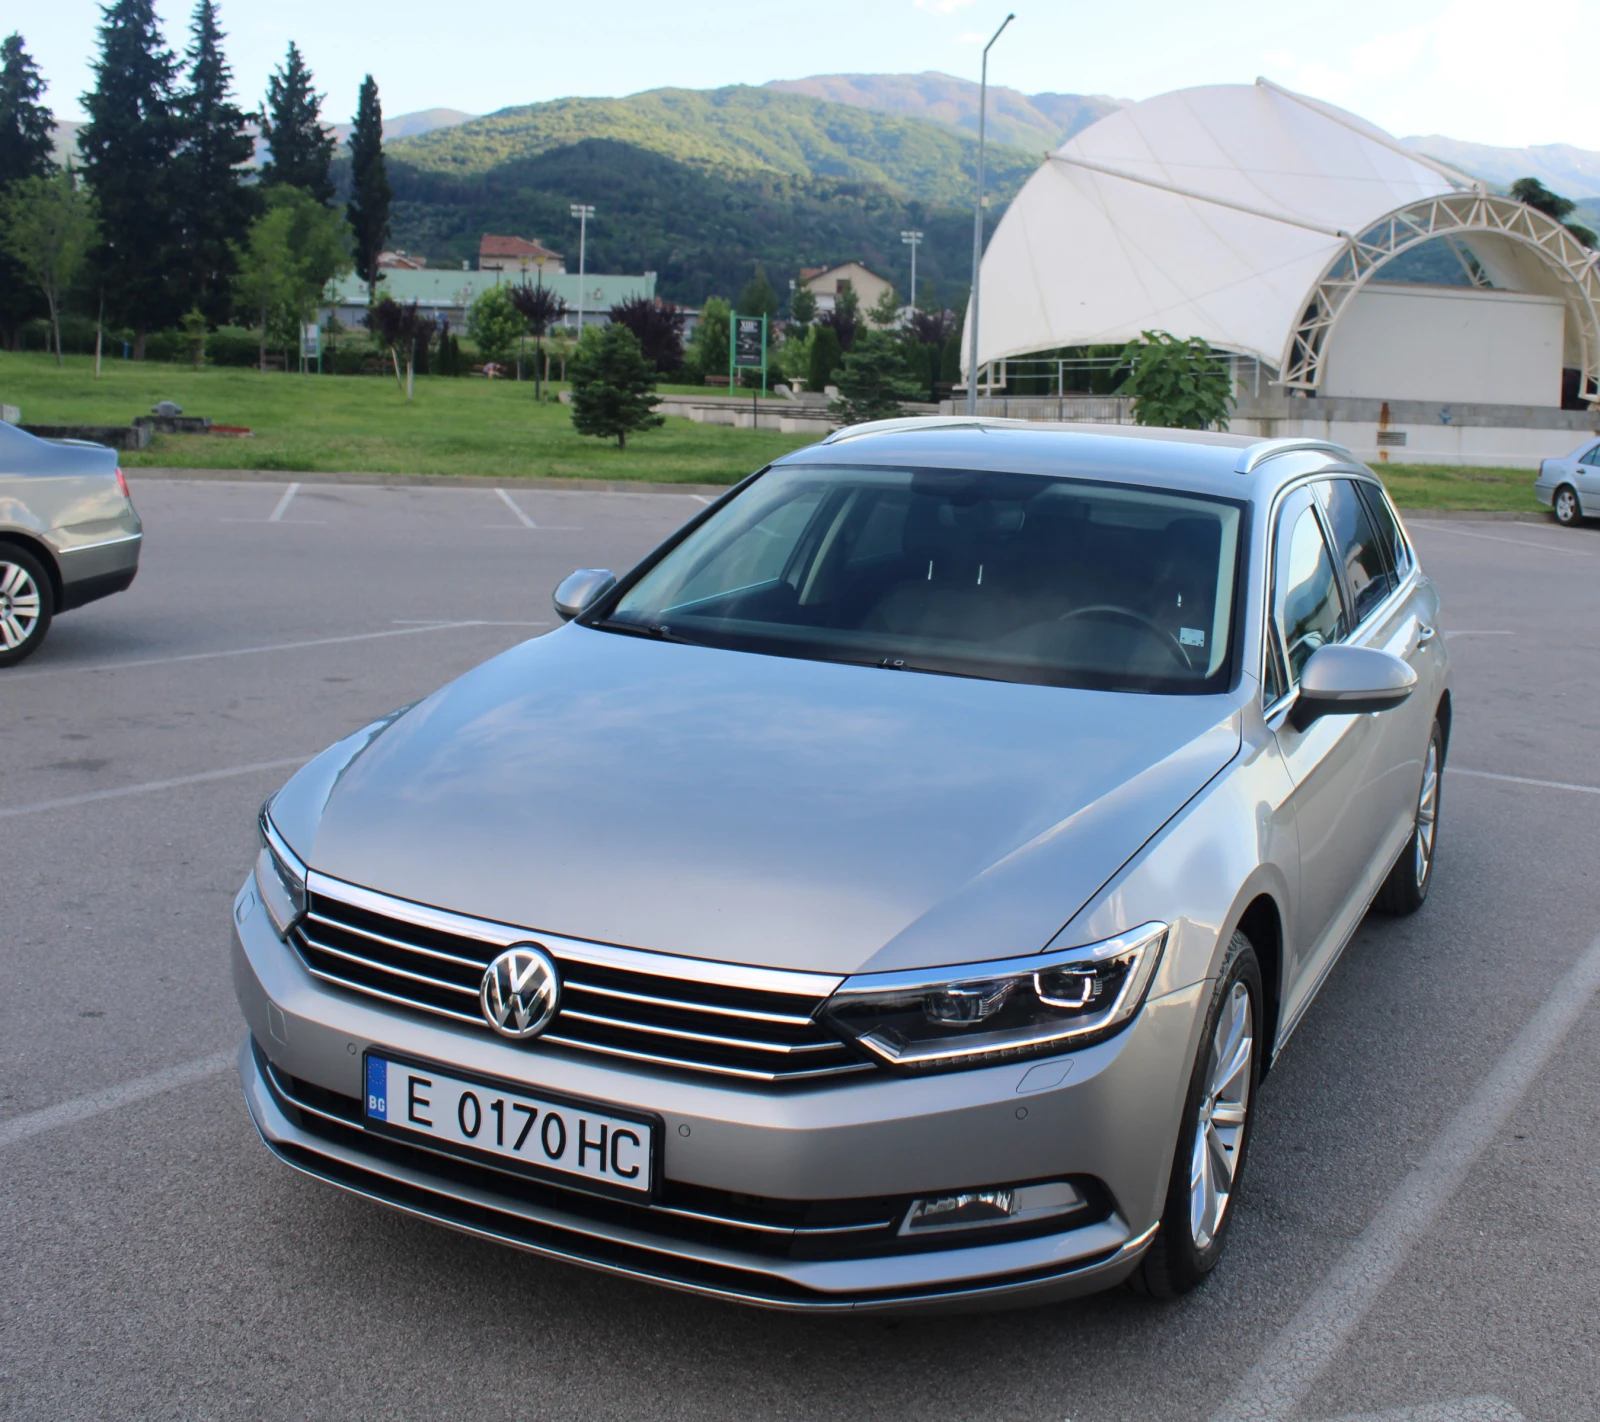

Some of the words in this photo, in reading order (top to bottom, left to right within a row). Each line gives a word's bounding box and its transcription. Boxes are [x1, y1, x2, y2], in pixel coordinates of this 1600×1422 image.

[369, 1094, 385, 1112] BG
[408, 1075, 433, 1127] E
[458, 1091, 567, 1160] 0170
[578, 1119, 641, 1179] HC
